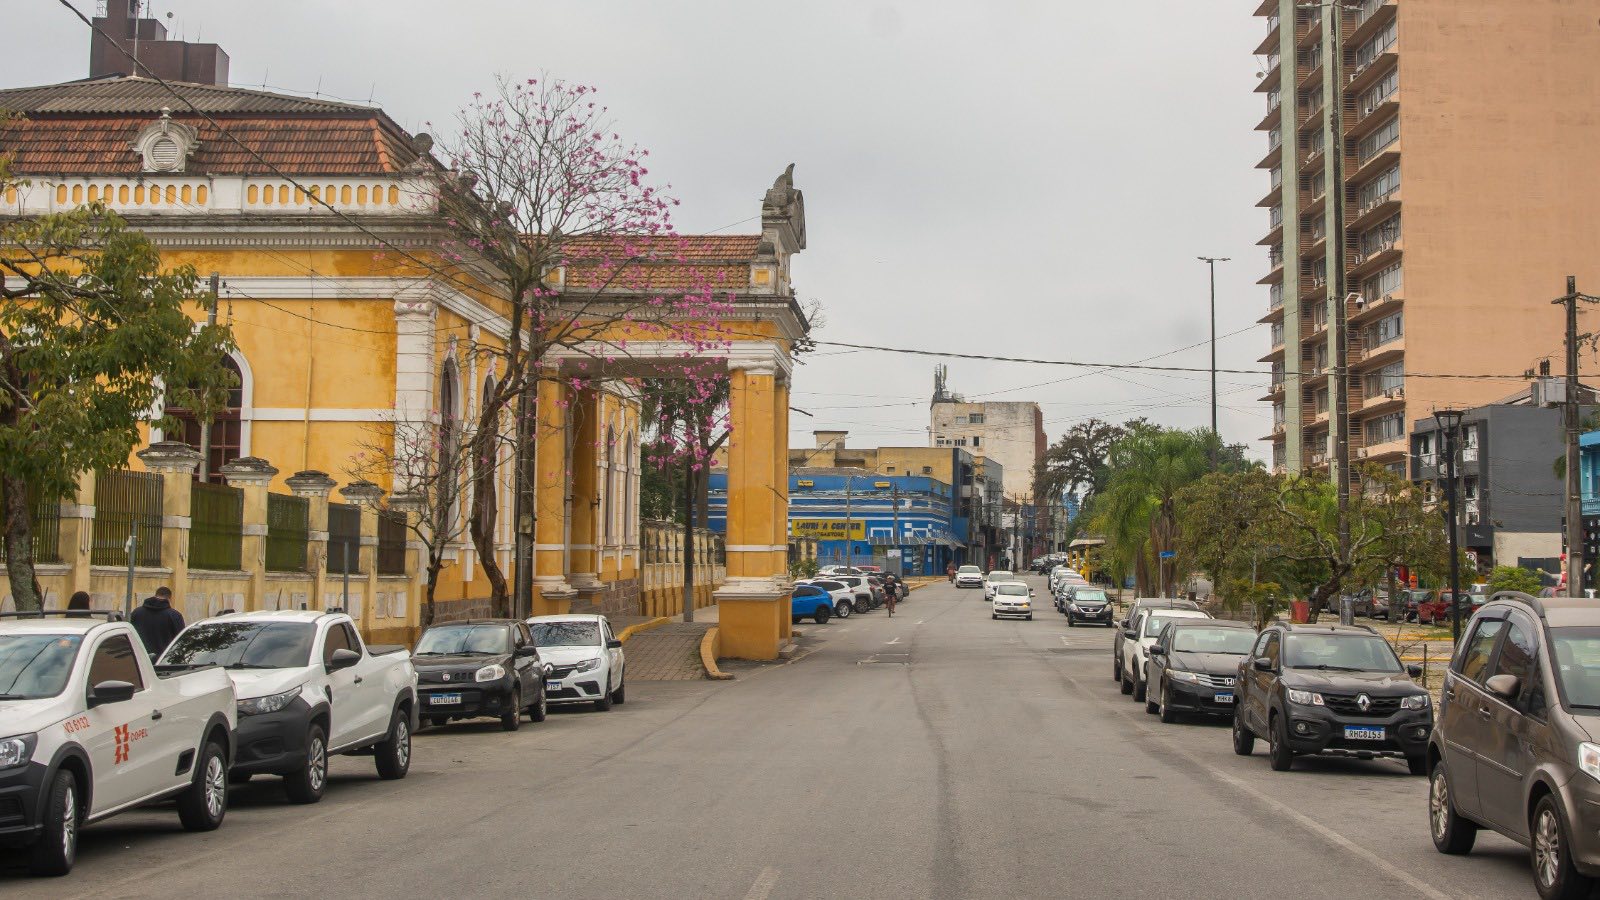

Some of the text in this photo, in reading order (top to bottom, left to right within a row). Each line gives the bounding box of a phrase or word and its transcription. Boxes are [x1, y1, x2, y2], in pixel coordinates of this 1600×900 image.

[831, 522, 861, 530] CENER
[73, 716, 91, 731] 6132
[130, 728, 149, 742] COPEL
